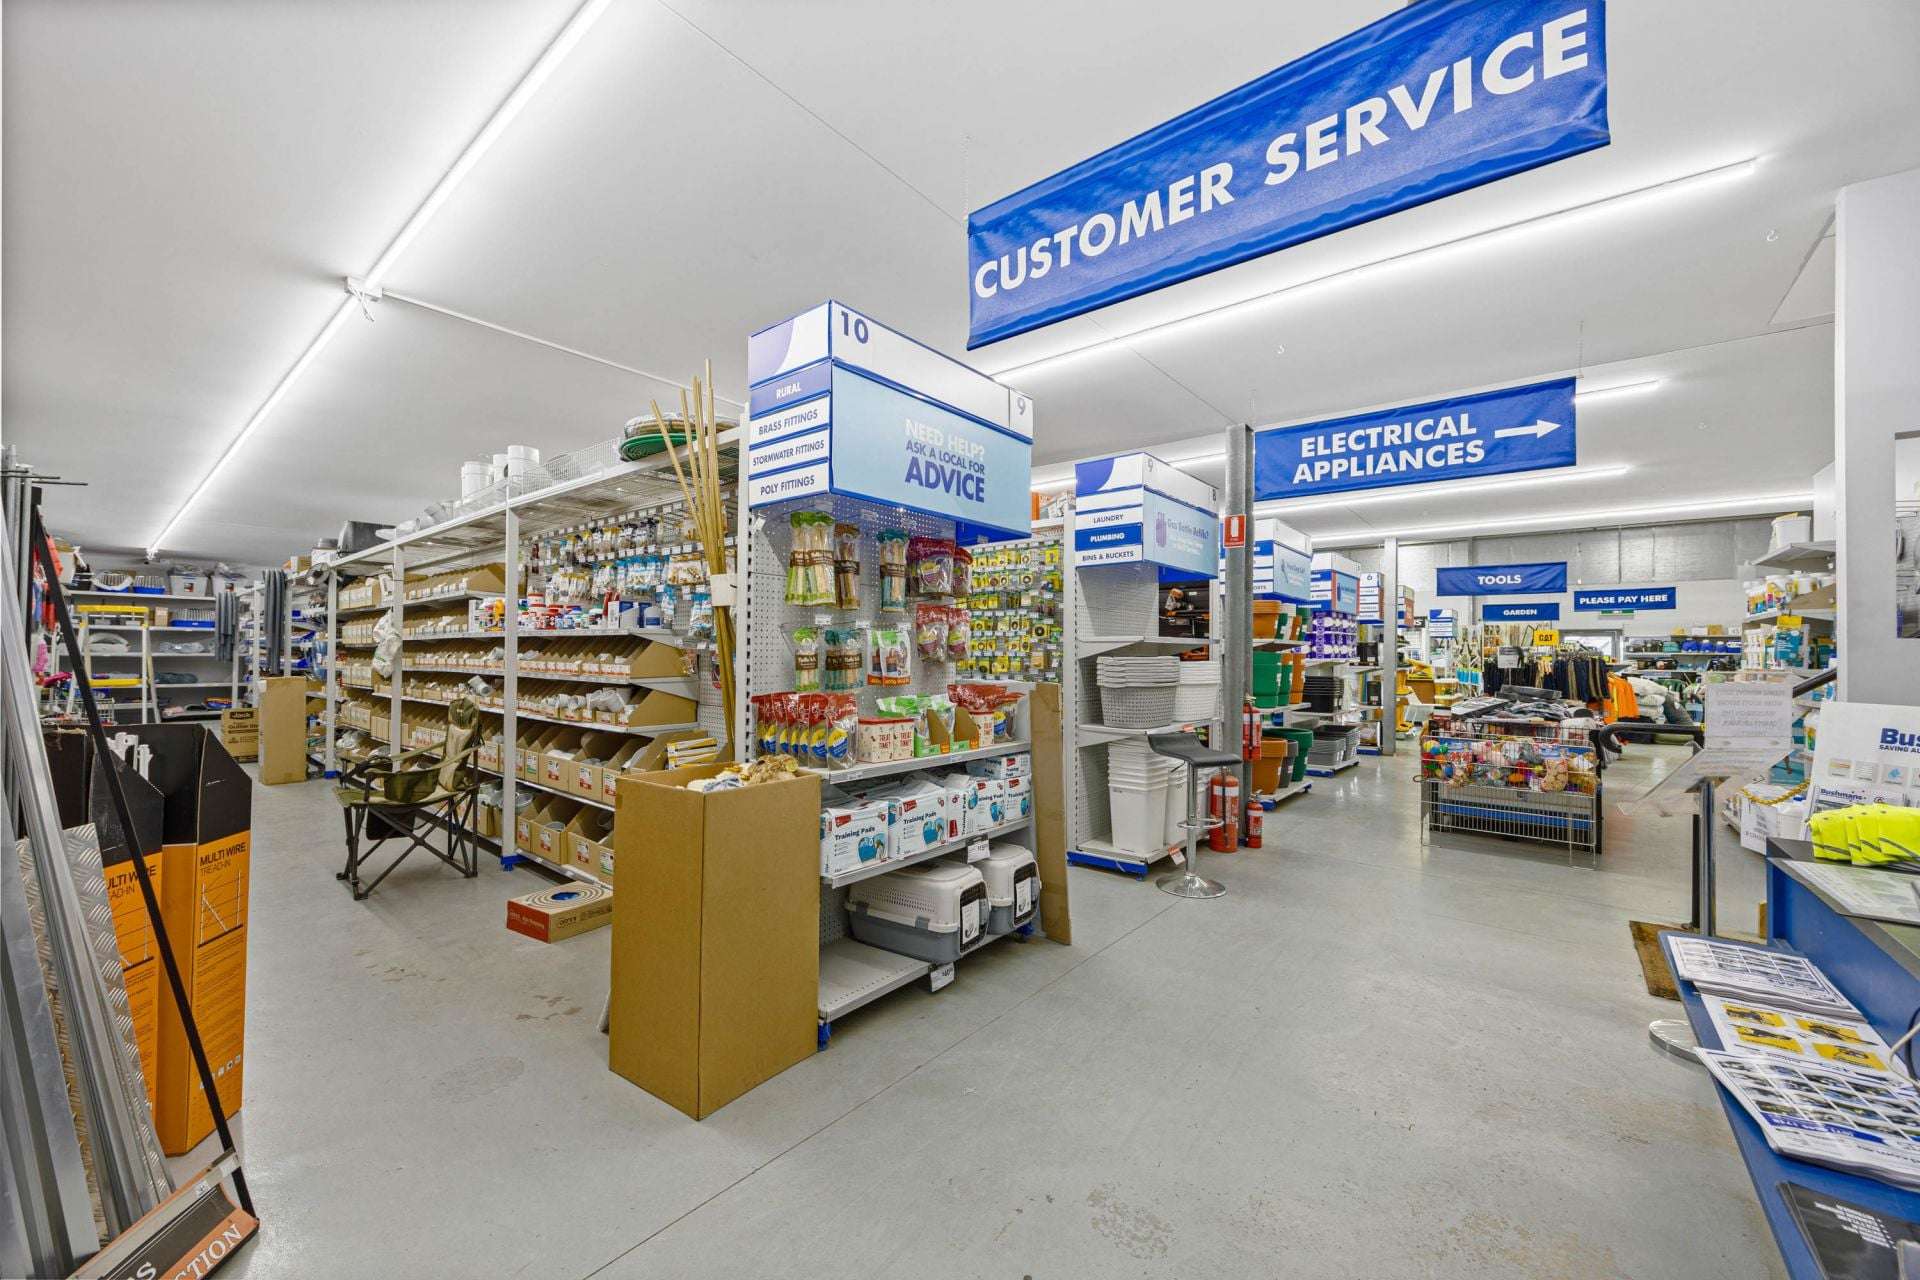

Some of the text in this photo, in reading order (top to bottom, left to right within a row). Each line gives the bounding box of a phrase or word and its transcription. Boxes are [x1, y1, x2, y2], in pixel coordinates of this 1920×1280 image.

[974, 8, 1589, 298] CUSTOMER SERVICE
[841, 310, 869, 344] 10
[775, 382, 802, 399] RURAL
[1016, 396, 1026, 415] 9
[758, 408, 818, 435] BRASS FITTINGS
[904, 418, 985, 461] NEED HELP?
[1301, 413, 1477, 458] ELECTRICAL
[752, 439, 825, 467] STORMWATER FITTINGS
[906, 440, 985, 474] ASK A LOCAL FOR
[1292, 439, 1485, 485] APPLIANCES
[1148, 458, 1153, 472] 9
[760, 474, 815, 496] POLY FITTINGS
[904, 455, 985, 503] ADVICE
[1093, 514, 1124, 524] LAUNDRY
[1090, 532, 1125, 543] PLUMBING
[1082, 554, 1097, 562] BINS
[1105, 550, 1134, 559] BUCKETS
[1477, 574, 1521, 585] TOOLS
[1580, 594, 1668, 605] PLEASE PAY HERE
[1879, 744, 1909, 752] SAVING
[1820, 788, 1863, 801] Bushmans
[904, 814, 924, 824] Training
[835, 826, 876, 841] Training Pads
[200, 842, 246, 867] MULTI WIRE
